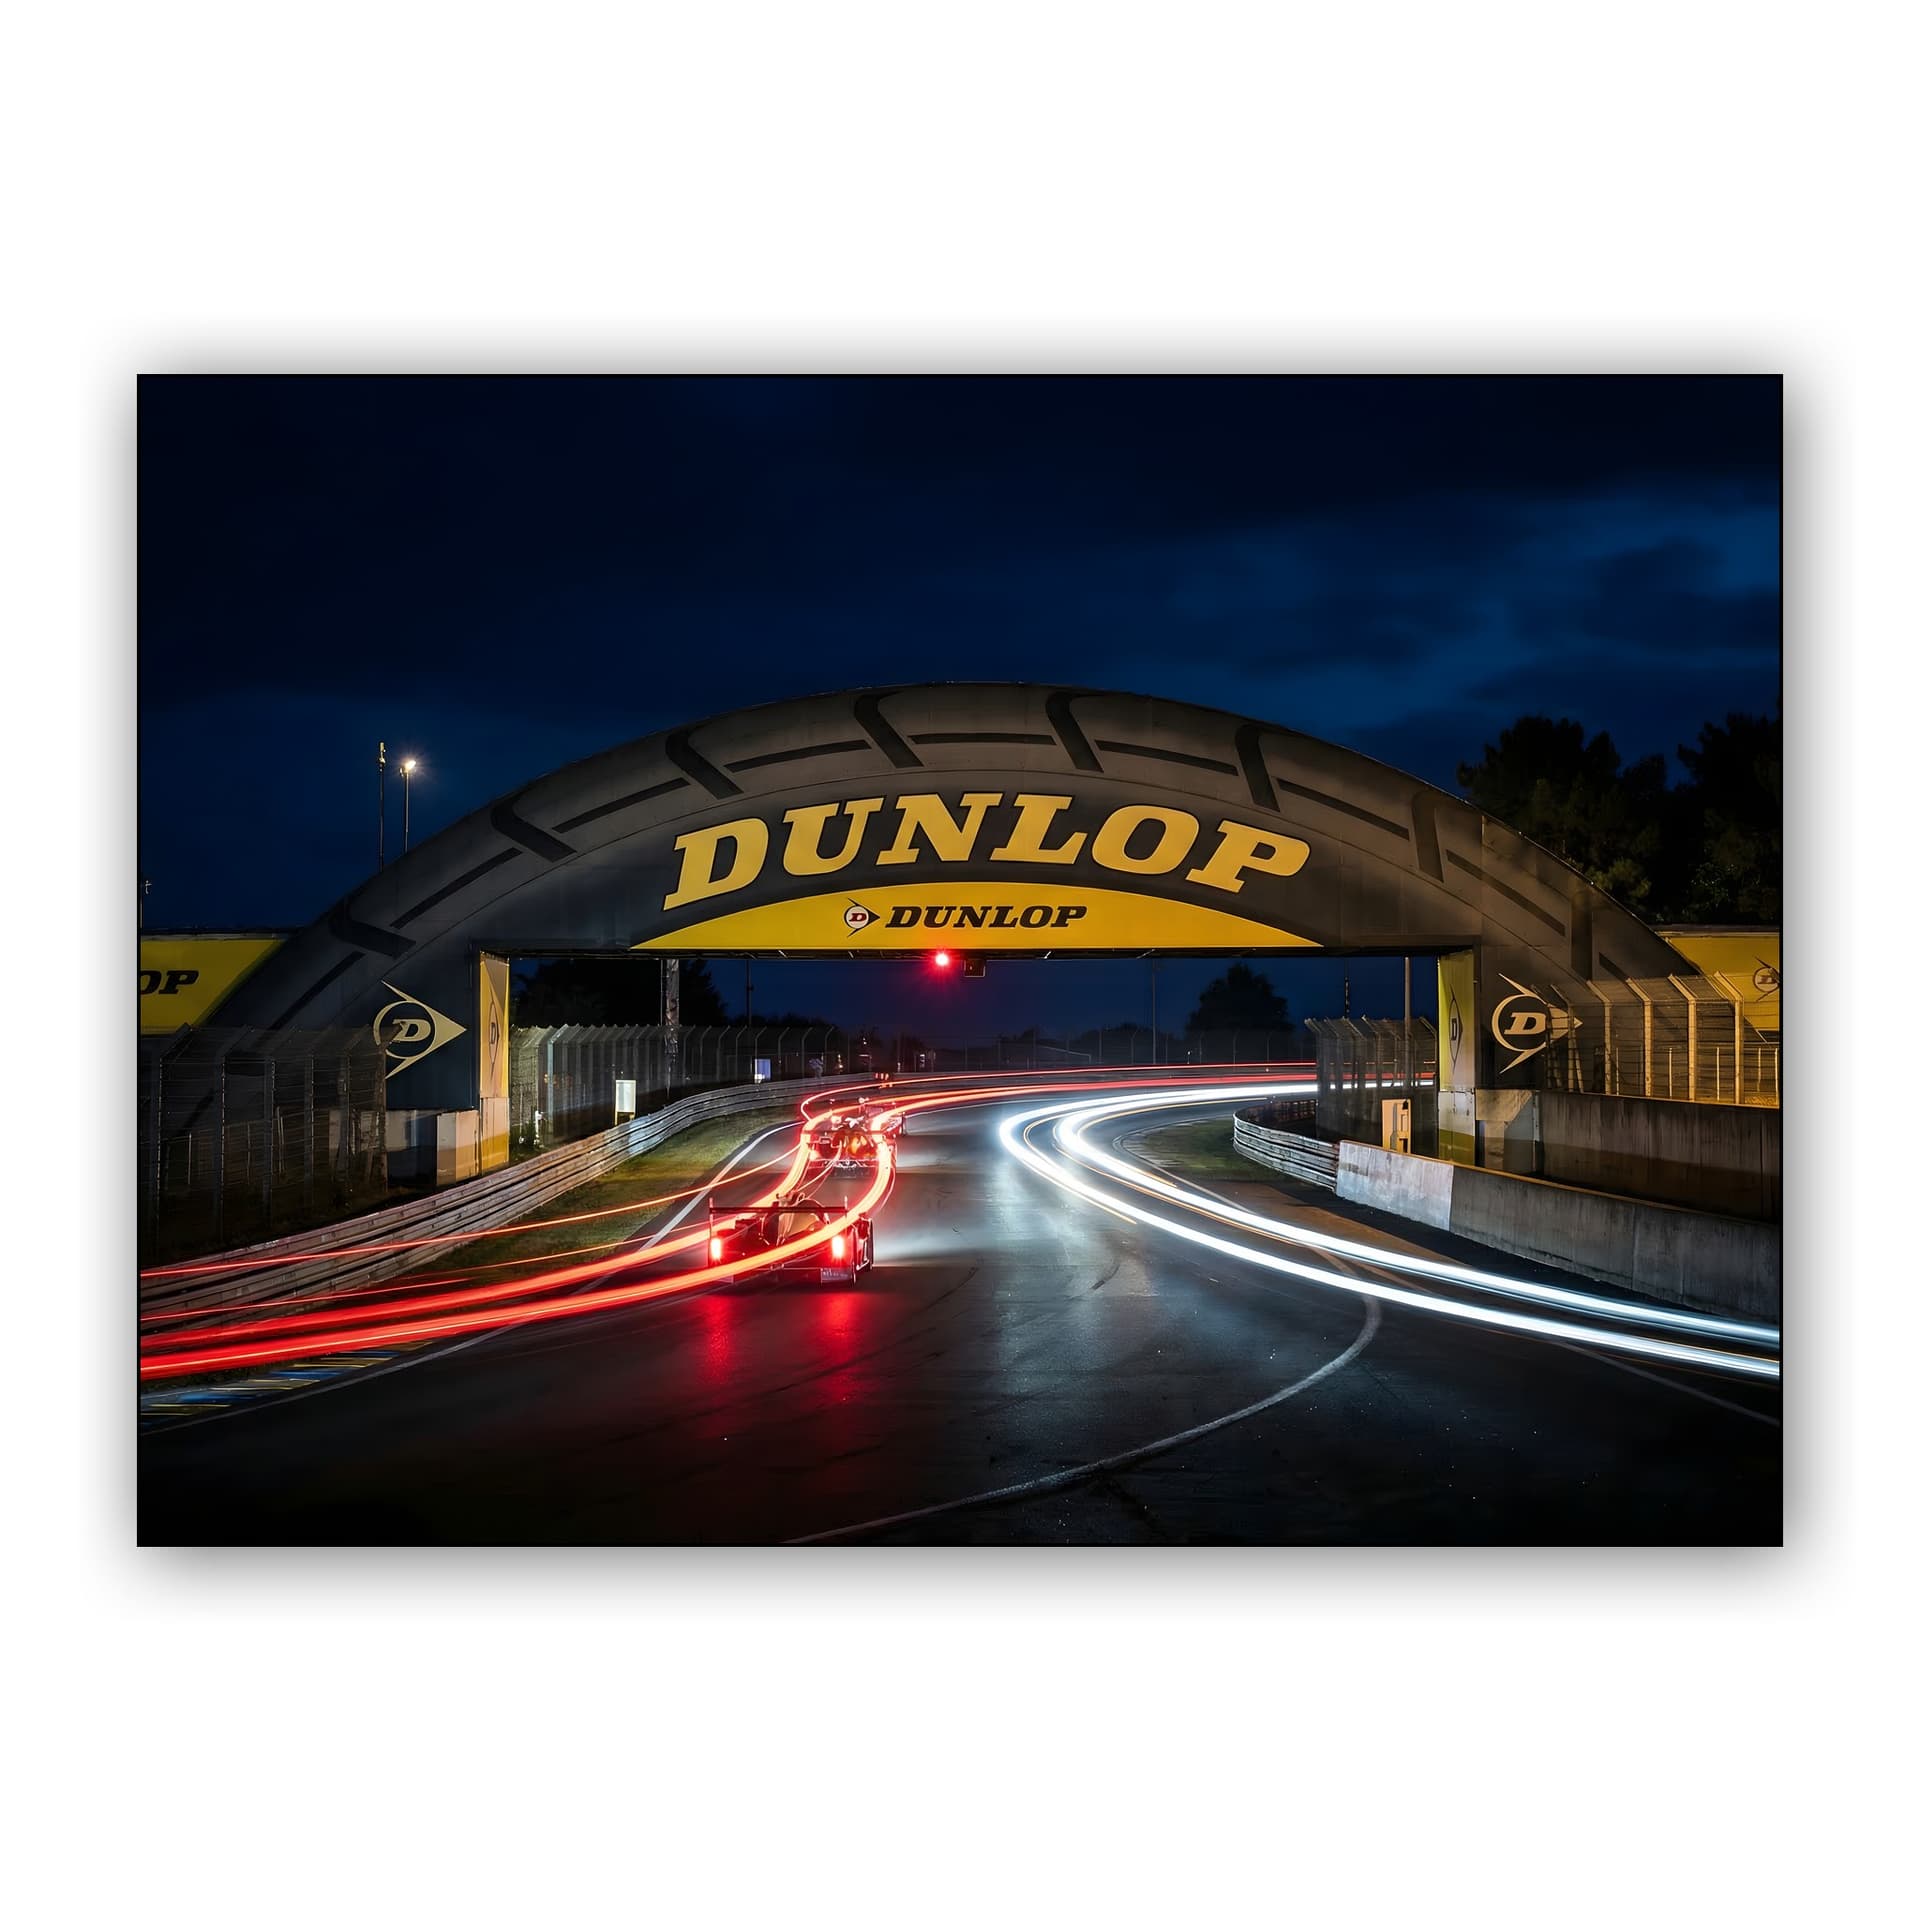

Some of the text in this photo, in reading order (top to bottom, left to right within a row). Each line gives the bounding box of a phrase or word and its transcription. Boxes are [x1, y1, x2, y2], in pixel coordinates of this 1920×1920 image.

[664, 793, 1310, 910] DUNLOP
[849, 905, 1088, 928] D DUNLOP
[391, 1019, 431, 1042] D
[1504, 1012, 1546, 1035] D
